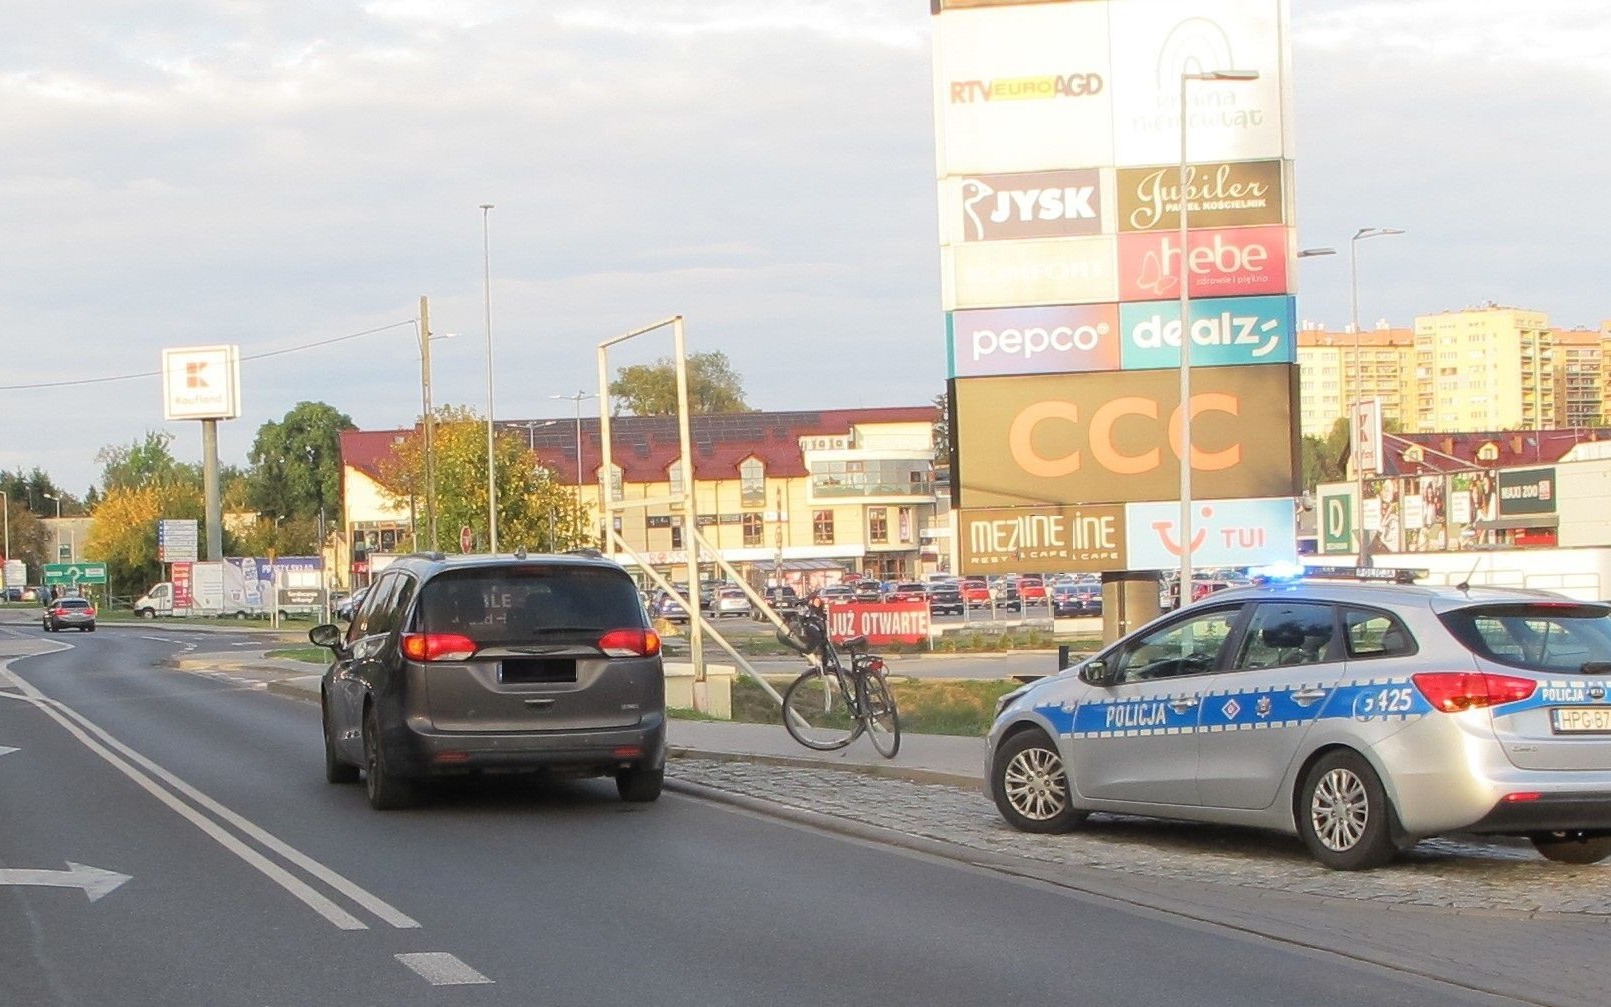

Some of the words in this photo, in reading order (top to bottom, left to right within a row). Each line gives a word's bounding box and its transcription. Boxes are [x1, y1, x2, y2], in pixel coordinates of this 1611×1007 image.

[950, 80, 993, 103] RTV
[994, 80, 1051, 96] EURO
[1054, 72, 1104, 97] AGD
[990, 186, 1097, 224] JYSK
[1130, 164, 1269, 230] Jubiler
[1161, 233, 1268, 276] hebe
[973, 324, 1099, 362] pepco
[1132, 312, 1260, 349] dealz
[1009, 392, 1244, 478] CCC
[1329, 499, 1344, 538] D
[1221, 528, 1264, 548] TUI
[831, 610, 856, 636] JUŻ
[861, 611, 928, 636] OTWARTE
[1541, 688, 1585, 702] POLICJA
[1105, 702, 1167, 728] POLICJA
